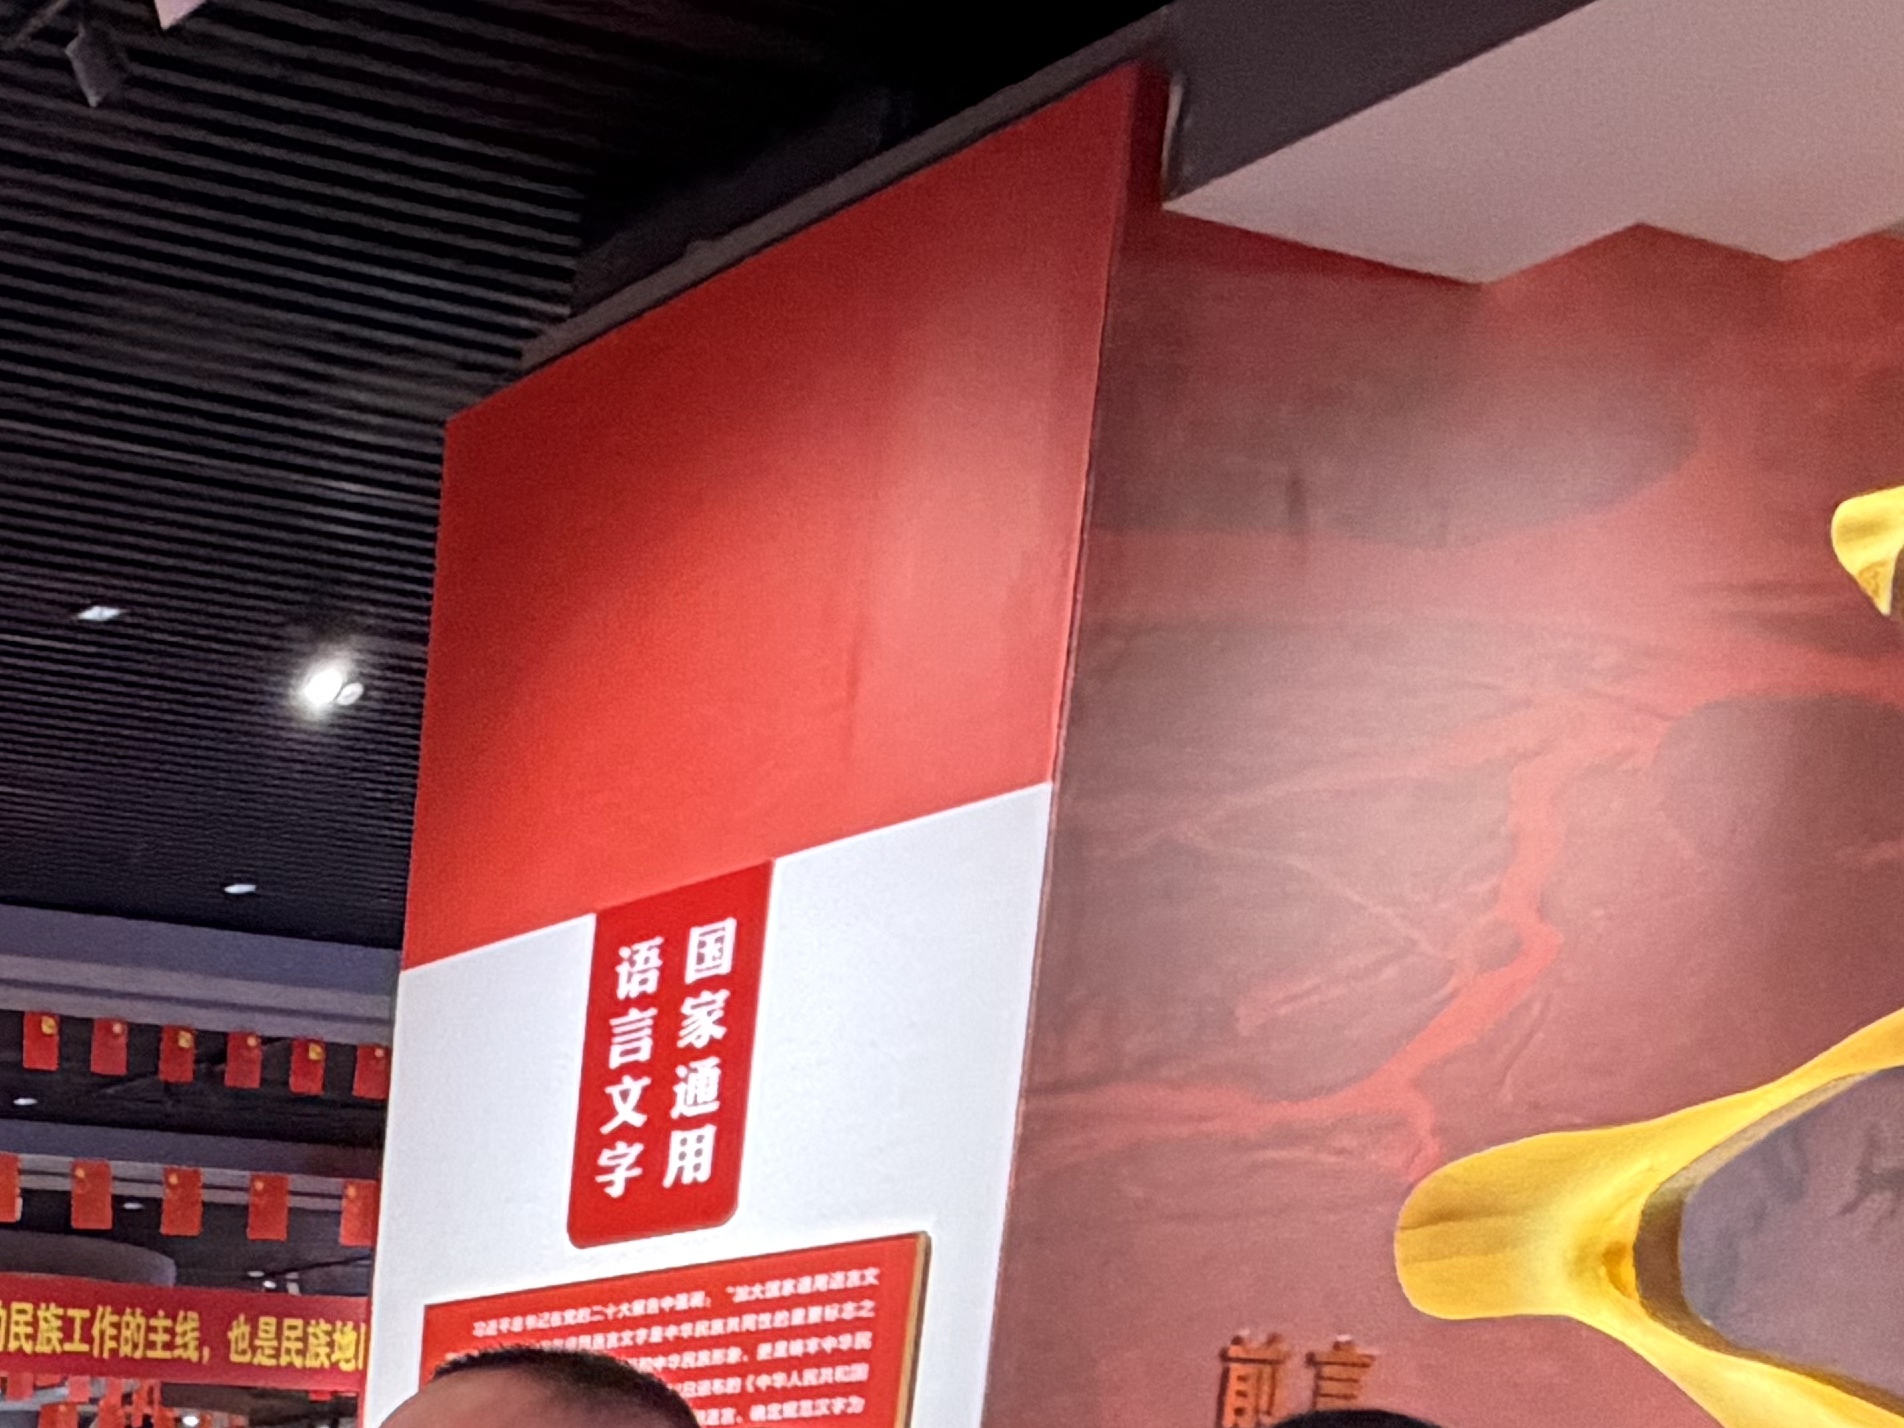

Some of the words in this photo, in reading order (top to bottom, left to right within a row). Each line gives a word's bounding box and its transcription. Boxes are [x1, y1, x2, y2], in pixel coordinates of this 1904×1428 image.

[594, 935, 664, 1198] 语言文字
[662, 916, 737, 1189] 国家通用
